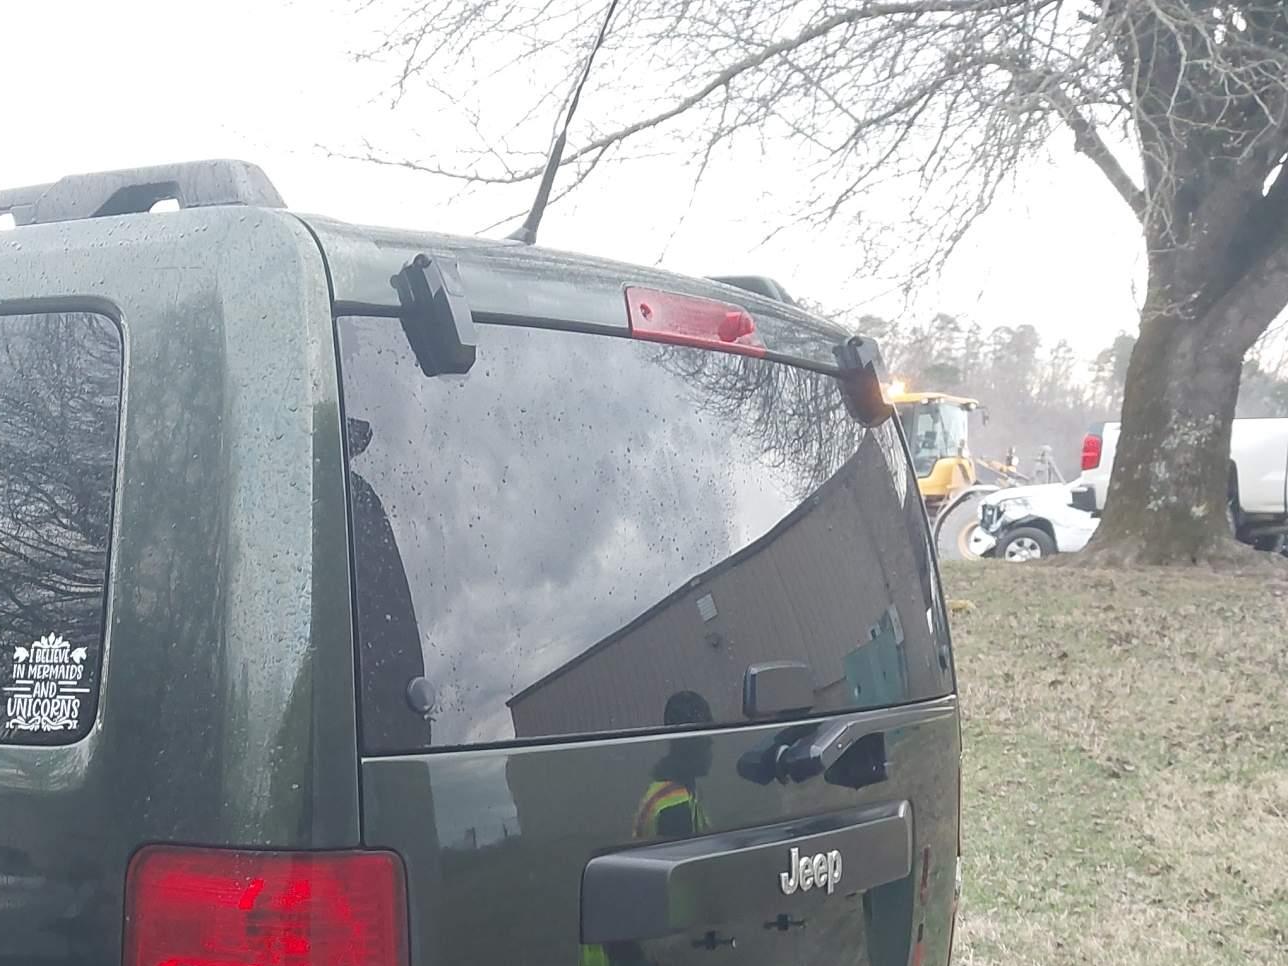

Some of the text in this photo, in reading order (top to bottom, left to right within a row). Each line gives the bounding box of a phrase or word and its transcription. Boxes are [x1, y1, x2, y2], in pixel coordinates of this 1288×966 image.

[35, 648, 70, 663] BELIEVE
[12, 664, 84, 680] IN MERMAIDS
[32, 681, 57, 698] AND
[7, 698, 80, 718] UNICORNS
[779, 847, 843, 896] Jeep
